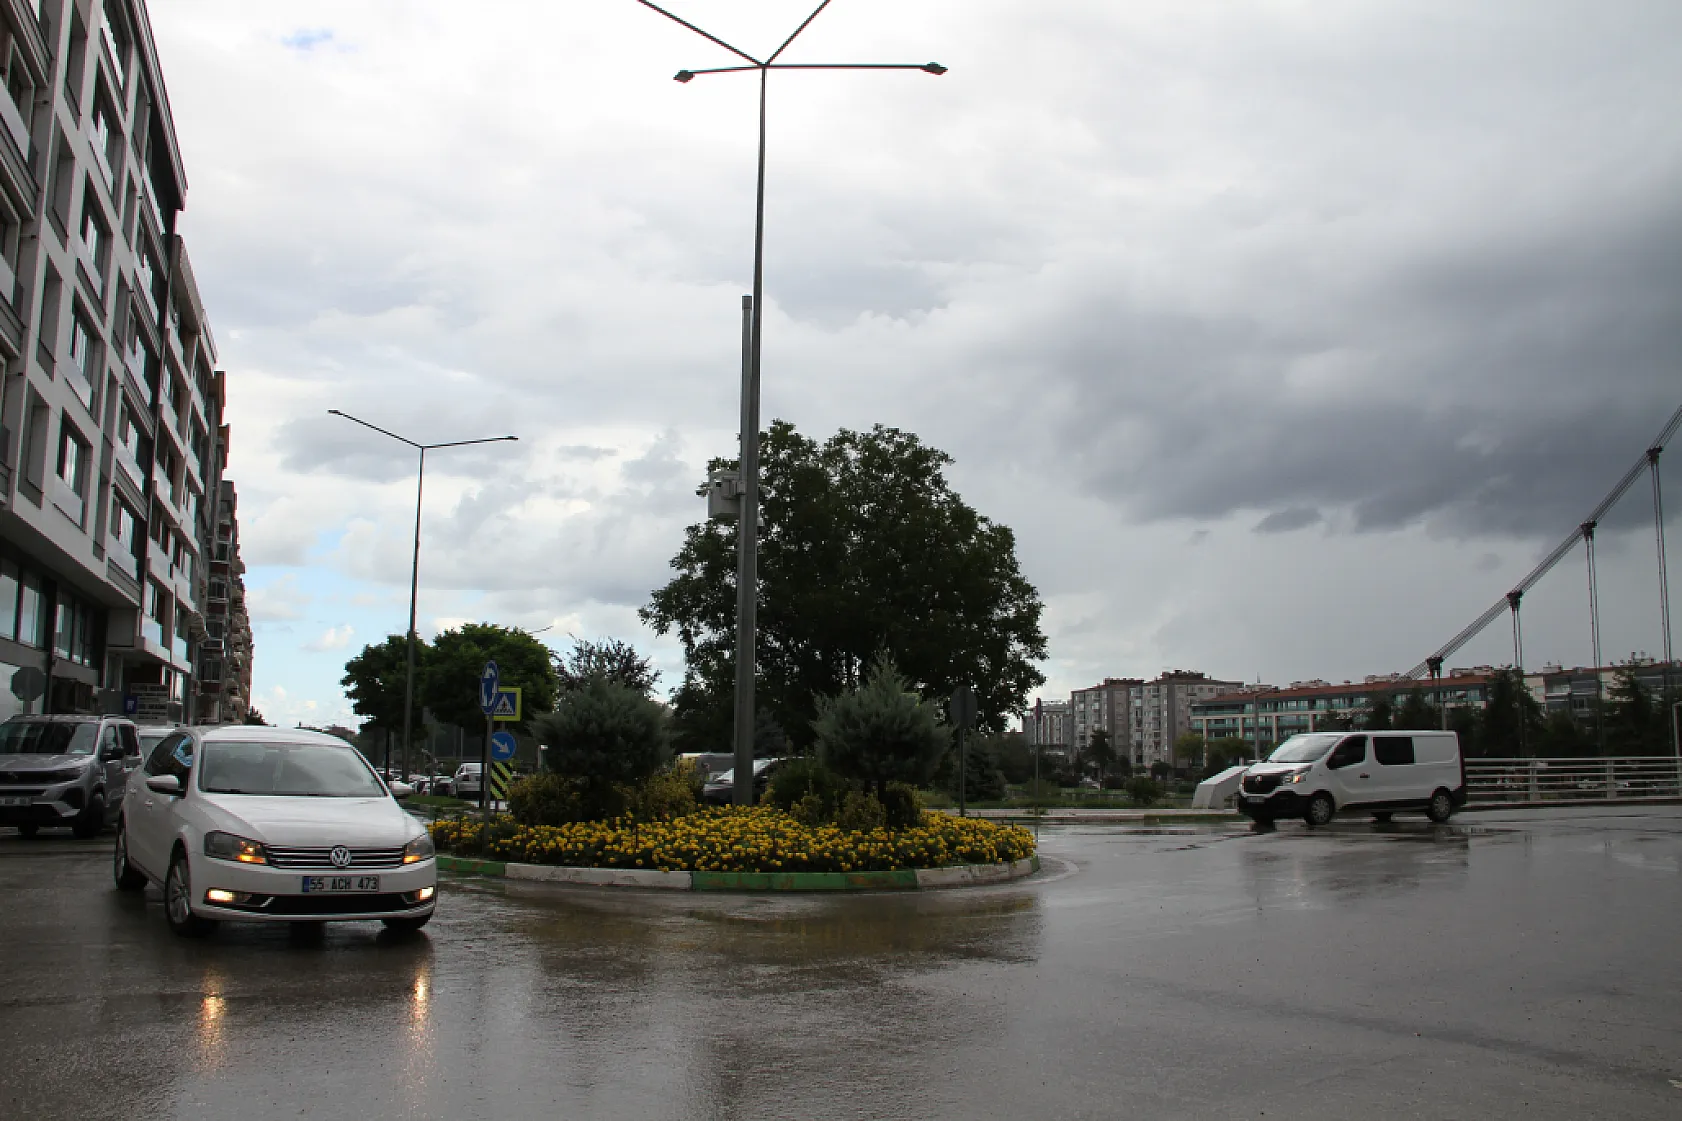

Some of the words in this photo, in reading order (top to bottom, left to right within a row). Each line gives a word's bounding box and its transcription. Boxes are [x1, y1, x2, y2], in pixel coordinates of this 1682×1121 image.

[310, 877, 324, 889] 55
[332, 877, 352, 889] ACH
[358, 876, 378, 889] 473
